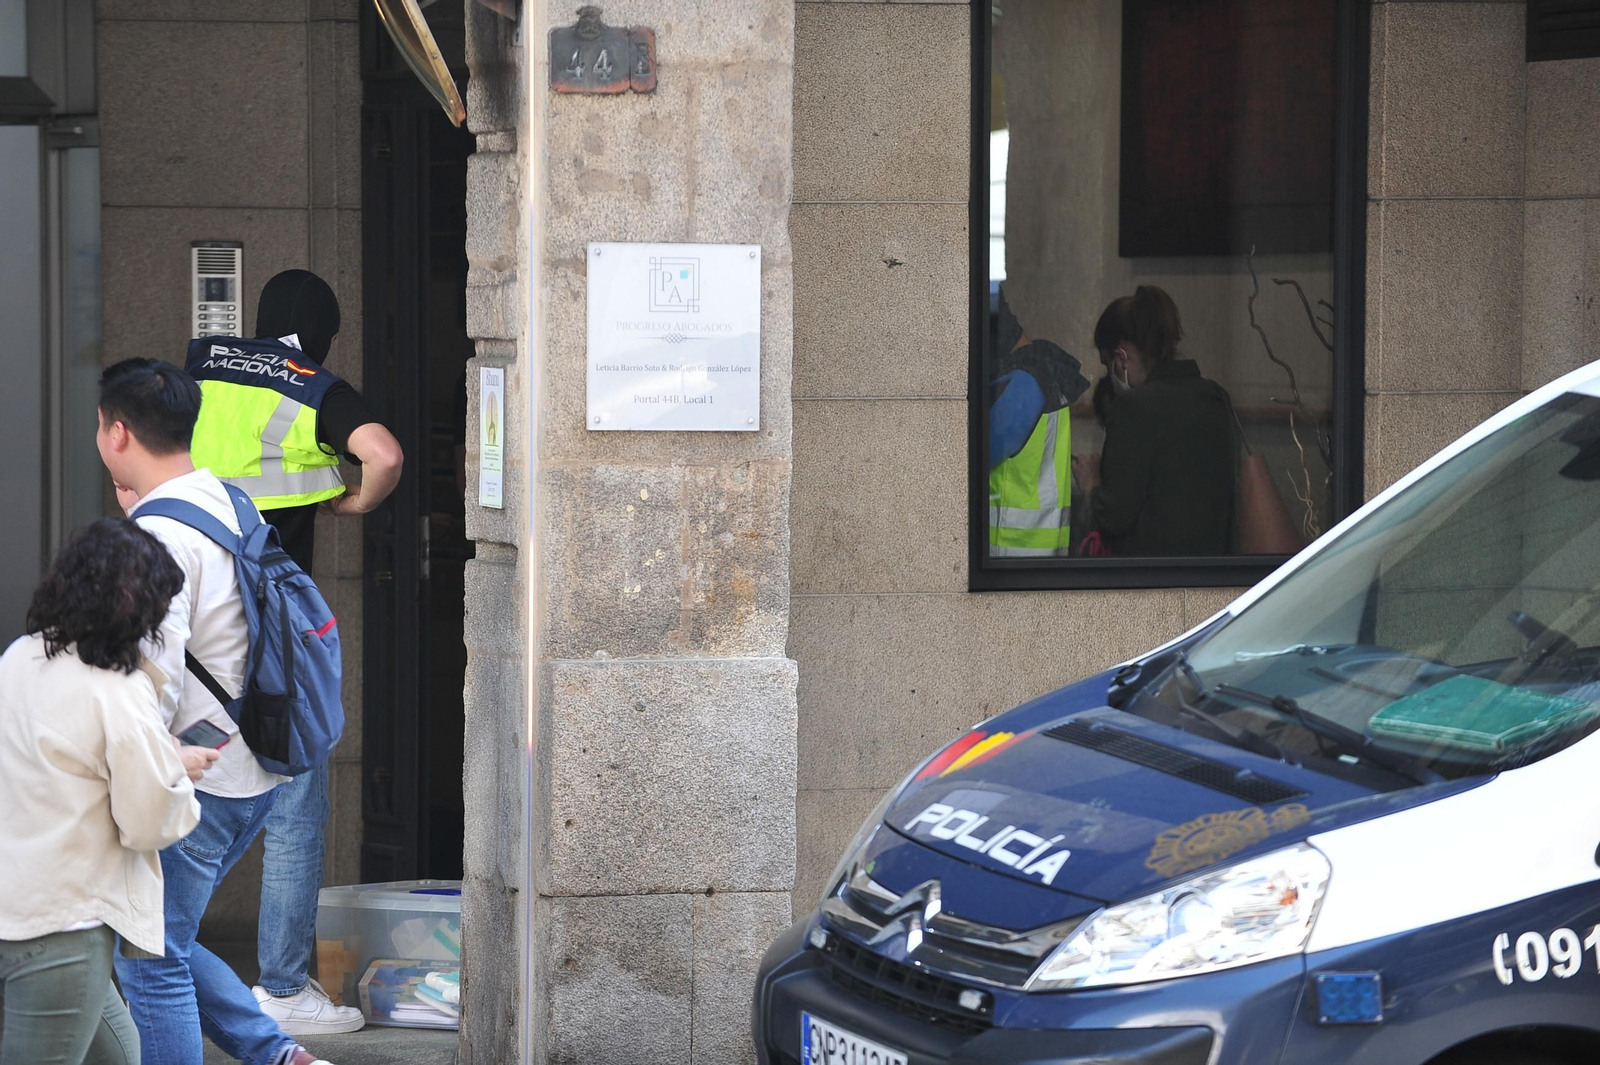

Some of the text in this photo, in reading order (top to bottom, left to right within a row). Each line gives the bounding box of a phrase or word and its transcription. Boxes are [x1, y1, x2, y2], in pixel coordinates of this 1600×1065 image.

[566, 48, 613, 79] 44
[661, 271, 673, 291] P
[668, 286, 682, 303] A
[616, 321, 733, 332] PROGRESO ABOGADOS
[202, 358, 305, 387] NACIONAL
[595, 364, 620, 372] Leticia
[621, 364, 643, 372] Barrio
[644, 364, 660, 372] Soto
[698, 364, 730, 373] González
[731, 364, 752, 374] López
[634, 395, 660, 404] Portal
[684, 395, 706, 404] Local
[904, 803, 1071, 885] POLICÍA
